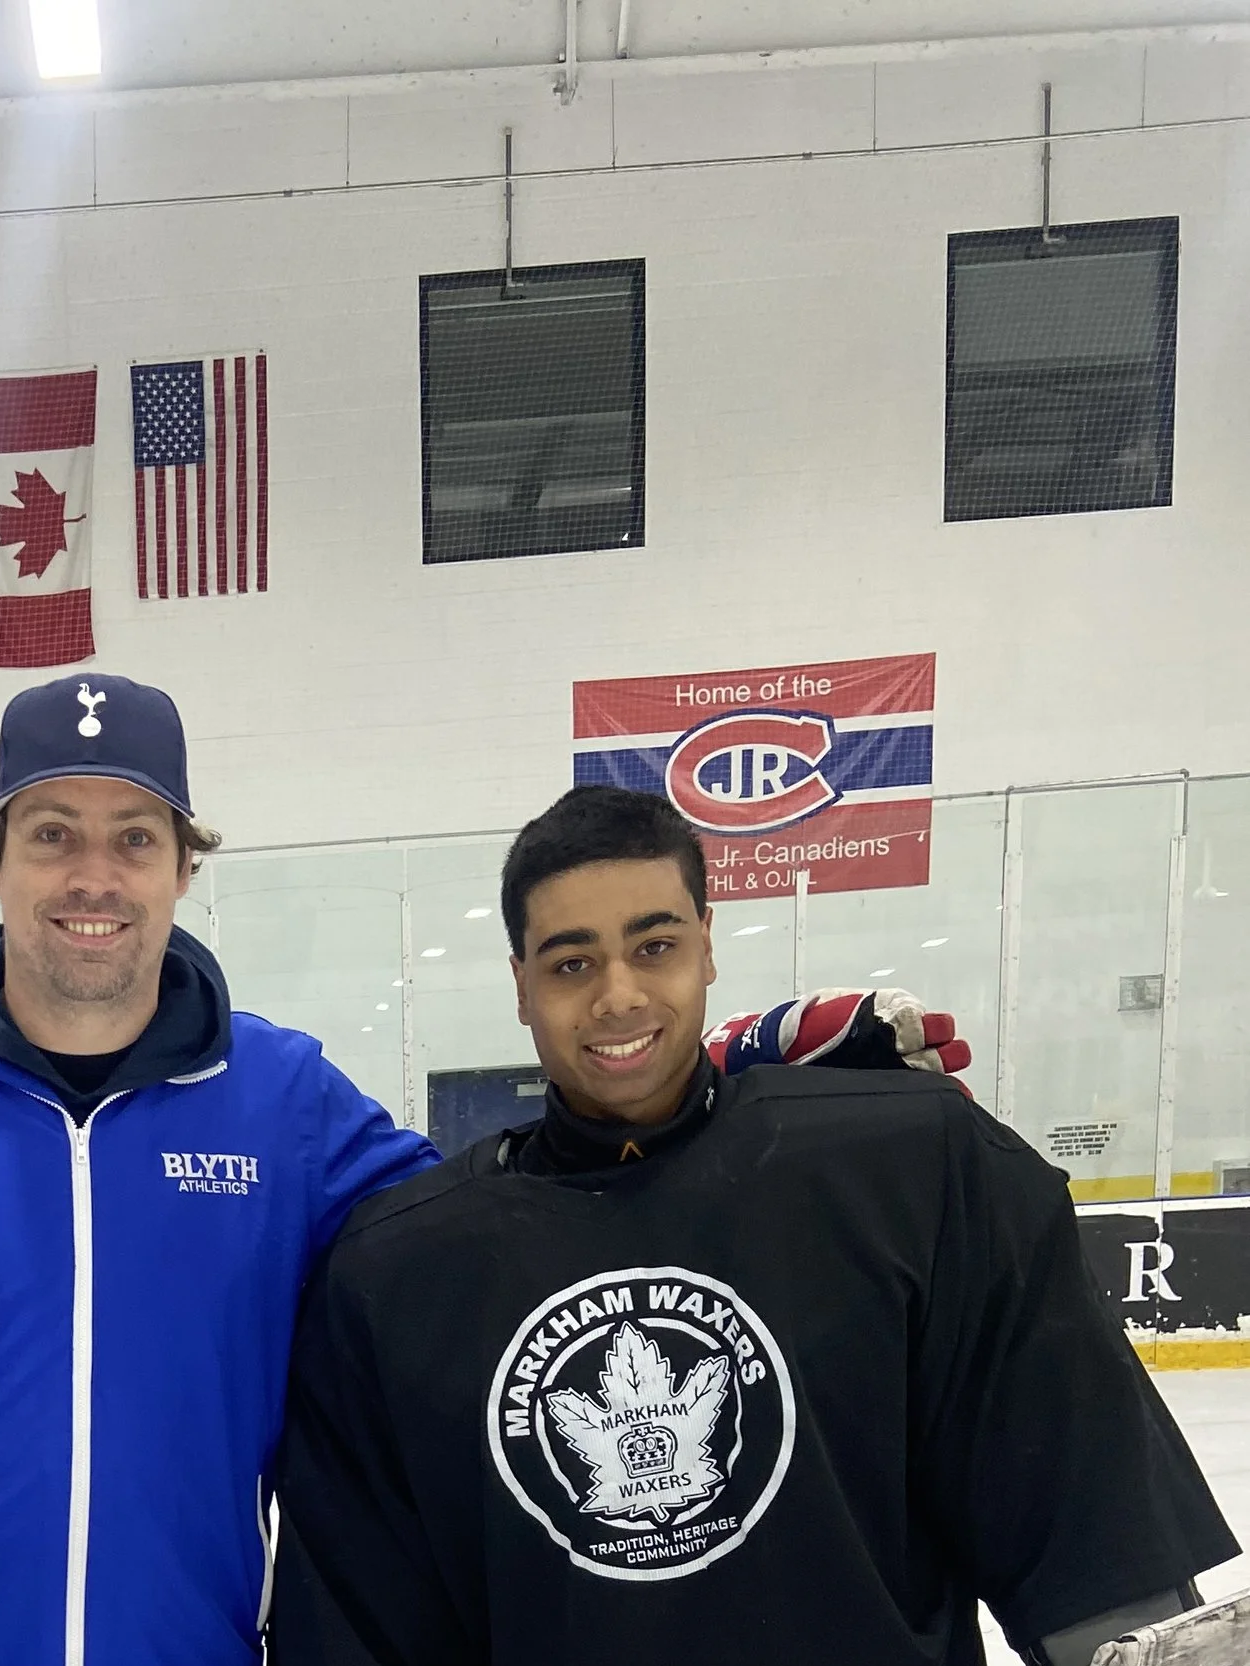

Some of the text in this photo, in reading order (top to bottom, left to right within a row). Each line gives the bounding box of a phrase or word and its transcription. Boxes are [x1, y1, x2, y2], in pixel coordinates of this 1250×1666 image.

[675, 673, 832, 707] Home of the
[711, 749, 788, 800] JR
[714, 836, 890, 869] Jr. Canadiens
[744, 872, 758, 890] &
[161, 1152, 260, 1183] BLYTH
[179, 1179, 249, 1196] ATHLETICS
[1121, 1242, 1182, 1303] R
[505, 1284, 767, 1438] MARKHAM WAXERS
[601, 1402, 689, 1432] MARKHAM
[618, 1472, 692, 1498] WAXERS
[589, 1516, 738, 1556] TRADITION, HERITAGE
[626, 1537, 708, 1564] COMMUNITY
